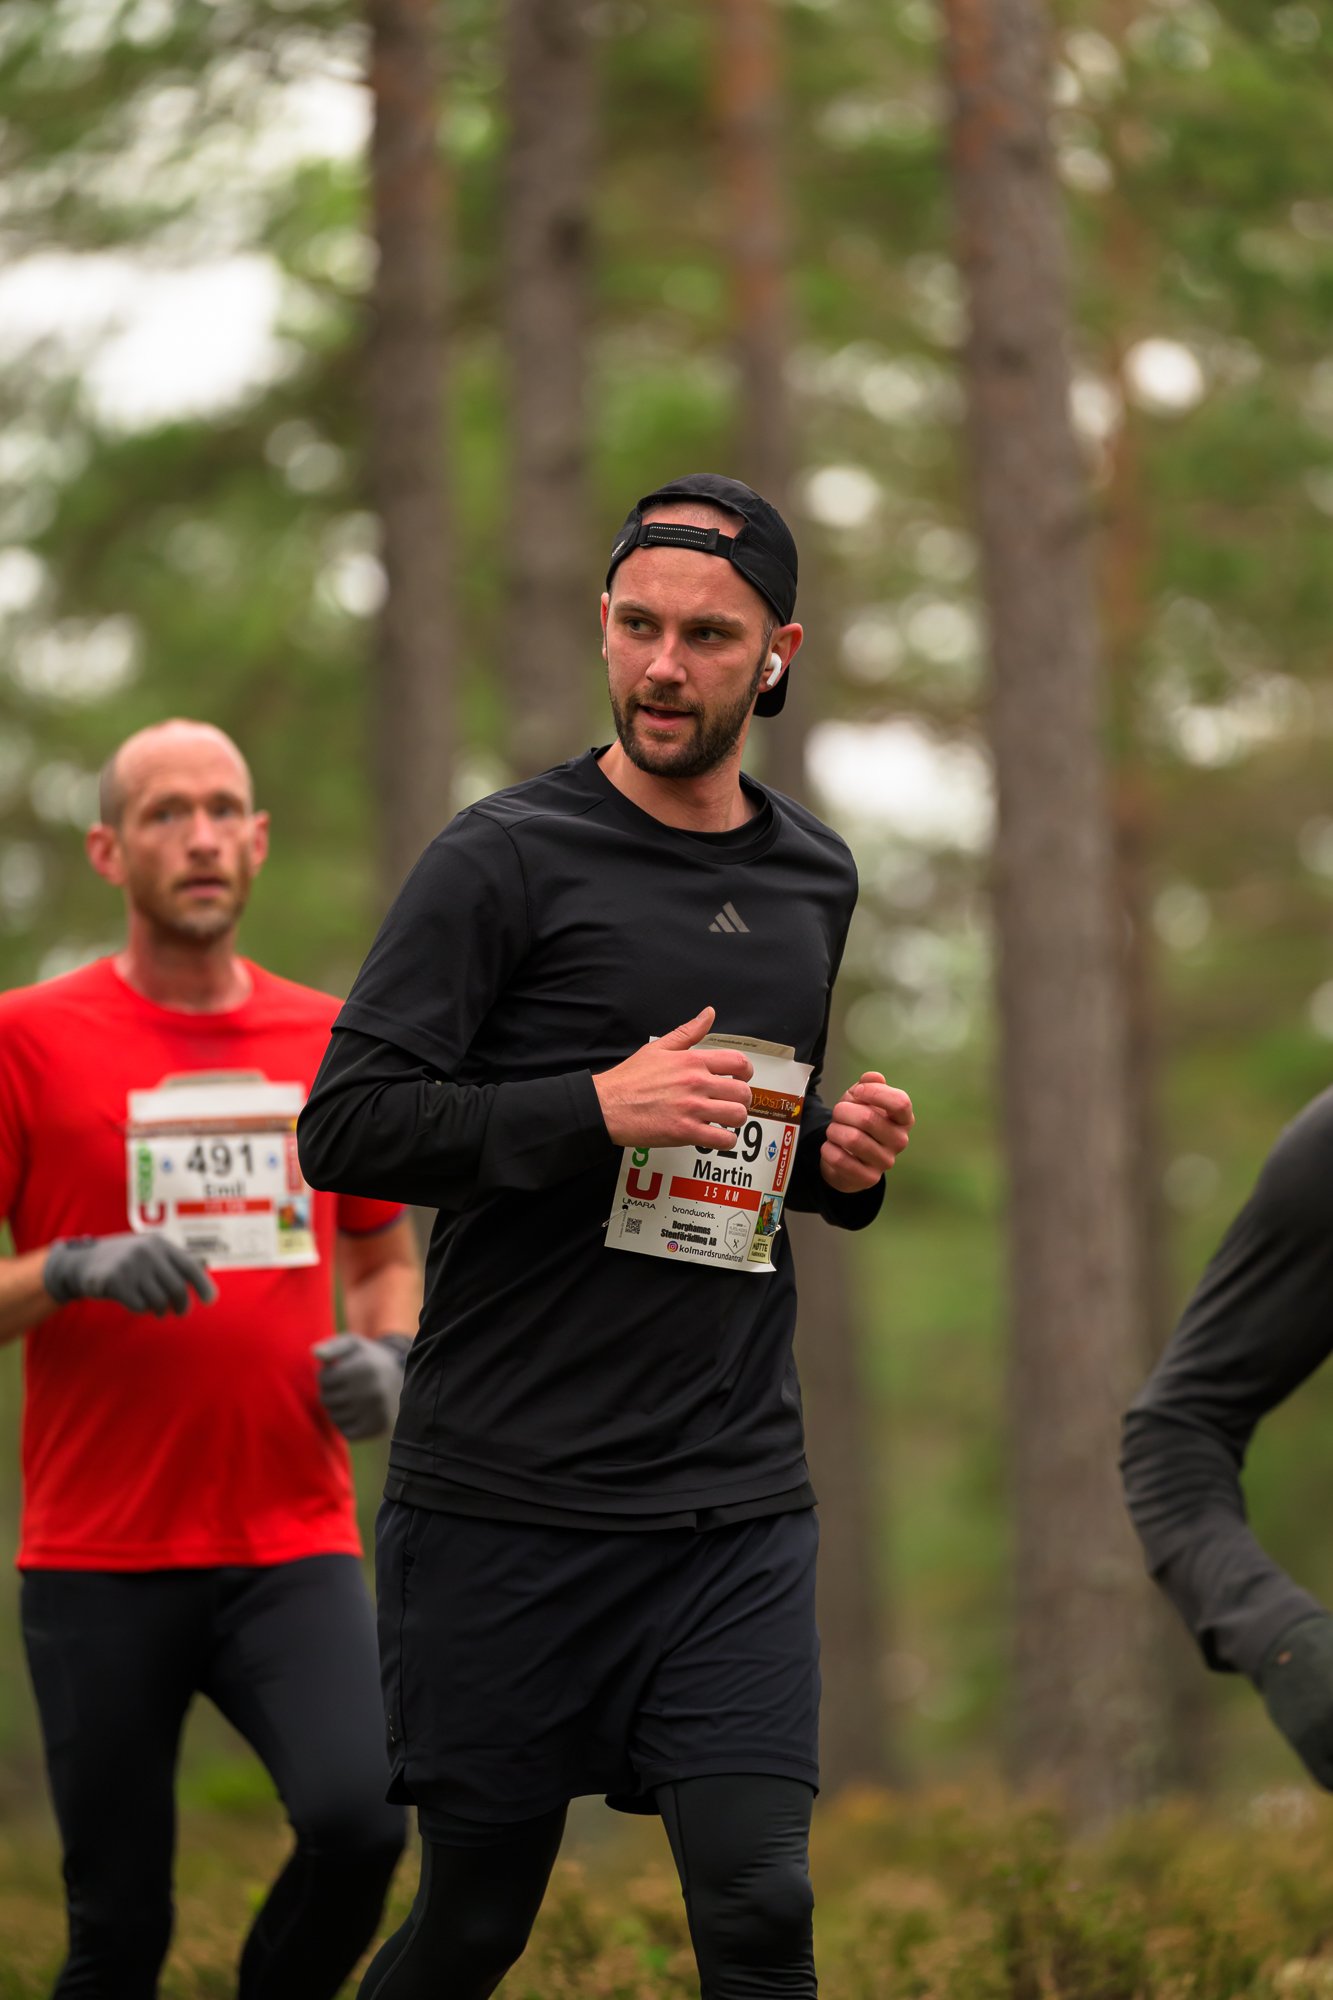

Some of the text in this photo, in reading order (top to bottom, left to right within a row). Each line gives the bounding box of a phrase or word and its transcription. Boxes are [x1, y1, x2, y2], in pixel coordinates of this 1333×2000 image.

[186, 1140, 254, 1175] 491
[775, 1146, 790, 1187] CIRCLE
[692, 1159, 753, 1188] Martin
[703, 1185, 740, 1203] 15 KM
[622, 1197, 657, 1211] UMARA
[671, 1220, 712, 1236] Borghamns
[708, 1237, 718, 1248] AB
